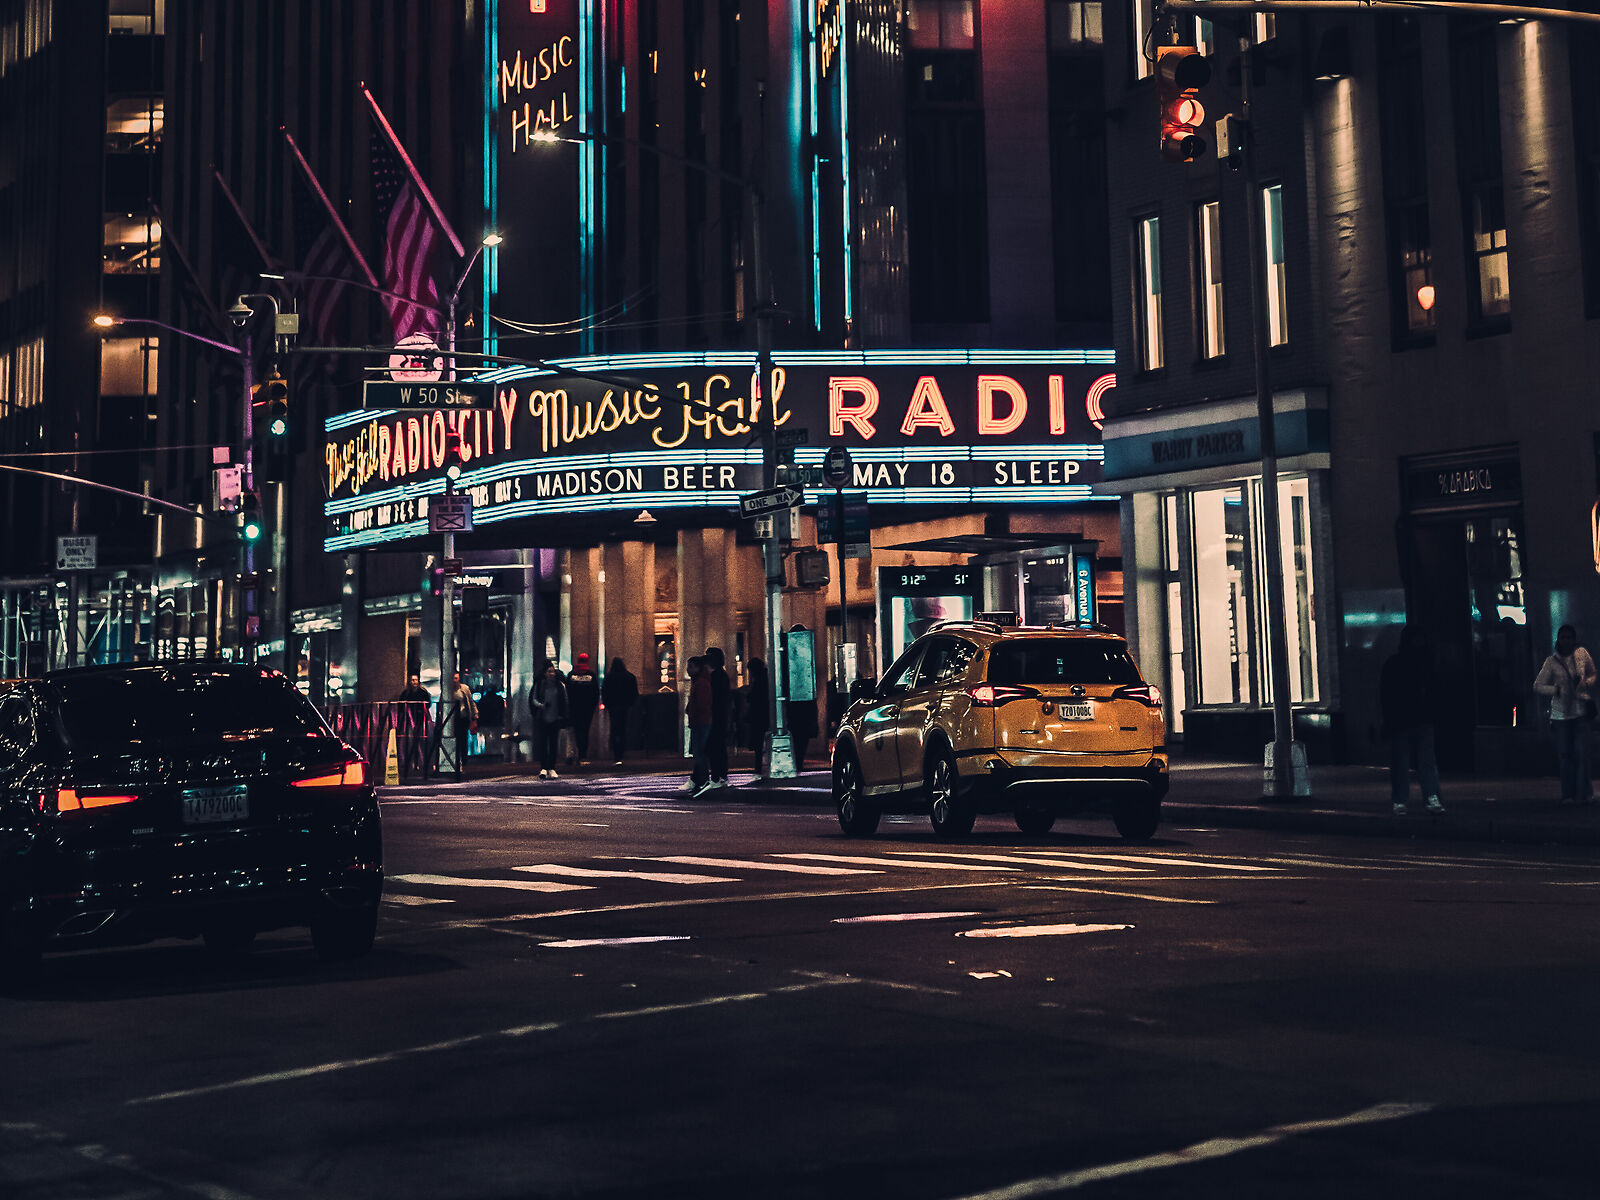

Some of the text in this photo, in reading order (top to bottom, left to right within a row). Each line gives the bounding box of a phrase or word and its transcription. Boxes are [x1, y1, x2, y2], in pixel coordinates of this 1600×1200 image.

[400, 387, 461, 405] W 50 St
[378, 410, 446, 482] RADIO
[537, 465, 736, 497] MADISON BEER
[853, 460, 1080, 487] MAY 18 SLEEP
[749, 490, 796, 510] ONE WAY
[1078, 578, 1090, 617] Avenue
